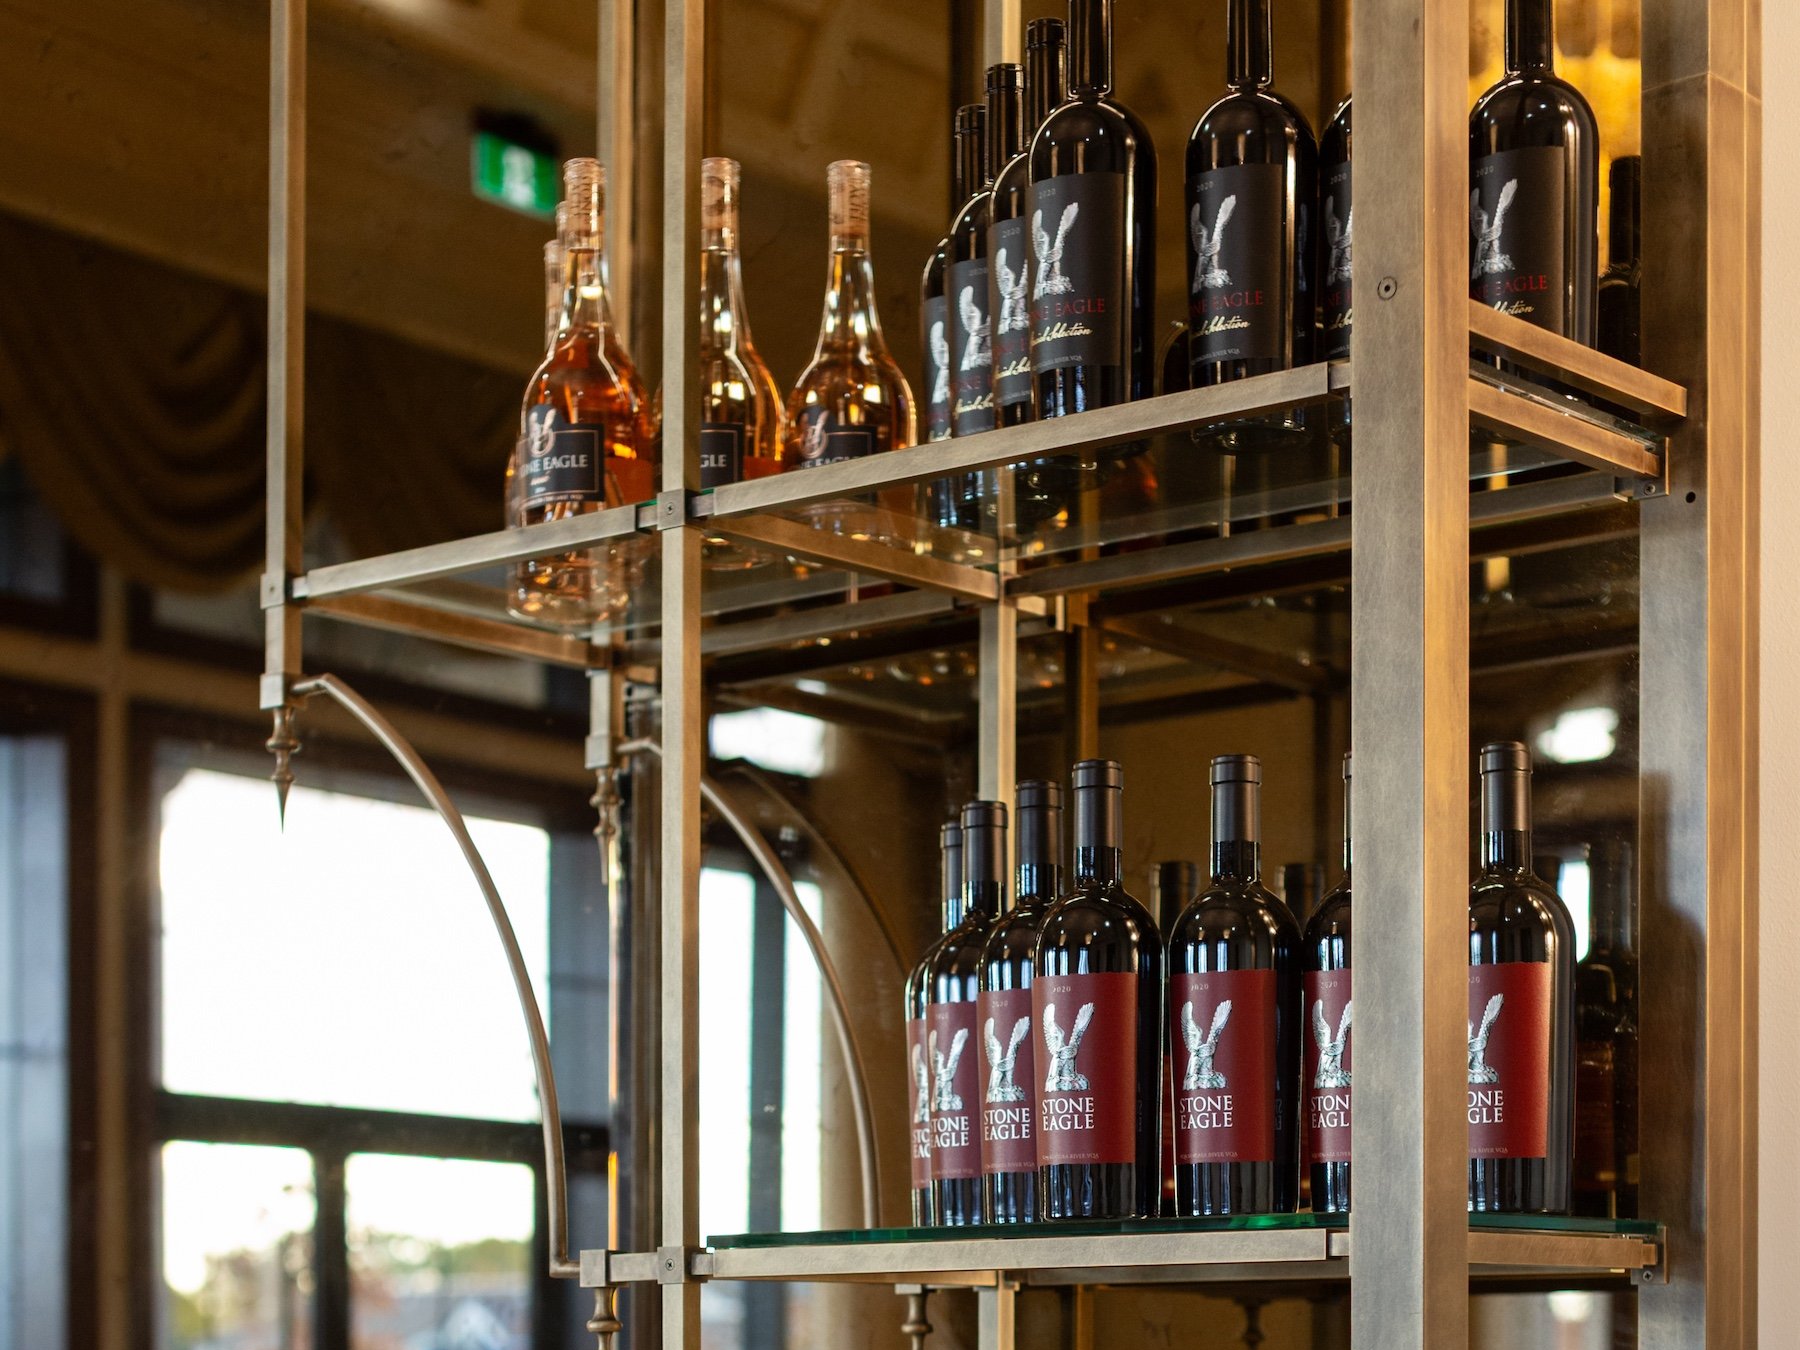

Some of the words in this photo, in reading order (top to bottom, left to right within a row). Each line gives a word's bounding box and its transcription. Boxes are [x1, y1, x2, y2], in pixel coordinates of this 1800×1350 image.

[1496, 274, 1549, 296] EAGLE
[1055, 297, 1106, 318] EAGLE
[1211, 288, 1265, 312] EAGLE
[543, 454, 589, 470] EAGLE
[700, 453, 728, 469] GLE
[1052, 985, 1072, 994] 2020
[1042, 1097, 1095, 1115] STONE
[1179, 1095, 1233, 1114] STONE
[1310, 1094, 1351, 1113] STON
[1467, 1090, 1504, 1108] ONE
[983, 1107, 1031, 1126] STONE
[1043, 1113, 1095, 1132] EAGLE
[1180, 1111, 1233, 1130] EAGLE
[1311, 1111, 1350, 1129] EAGL
[1467, 1107, 1504, 1125] GLE
[984, 1123, 1031, 1141] EAGLE
